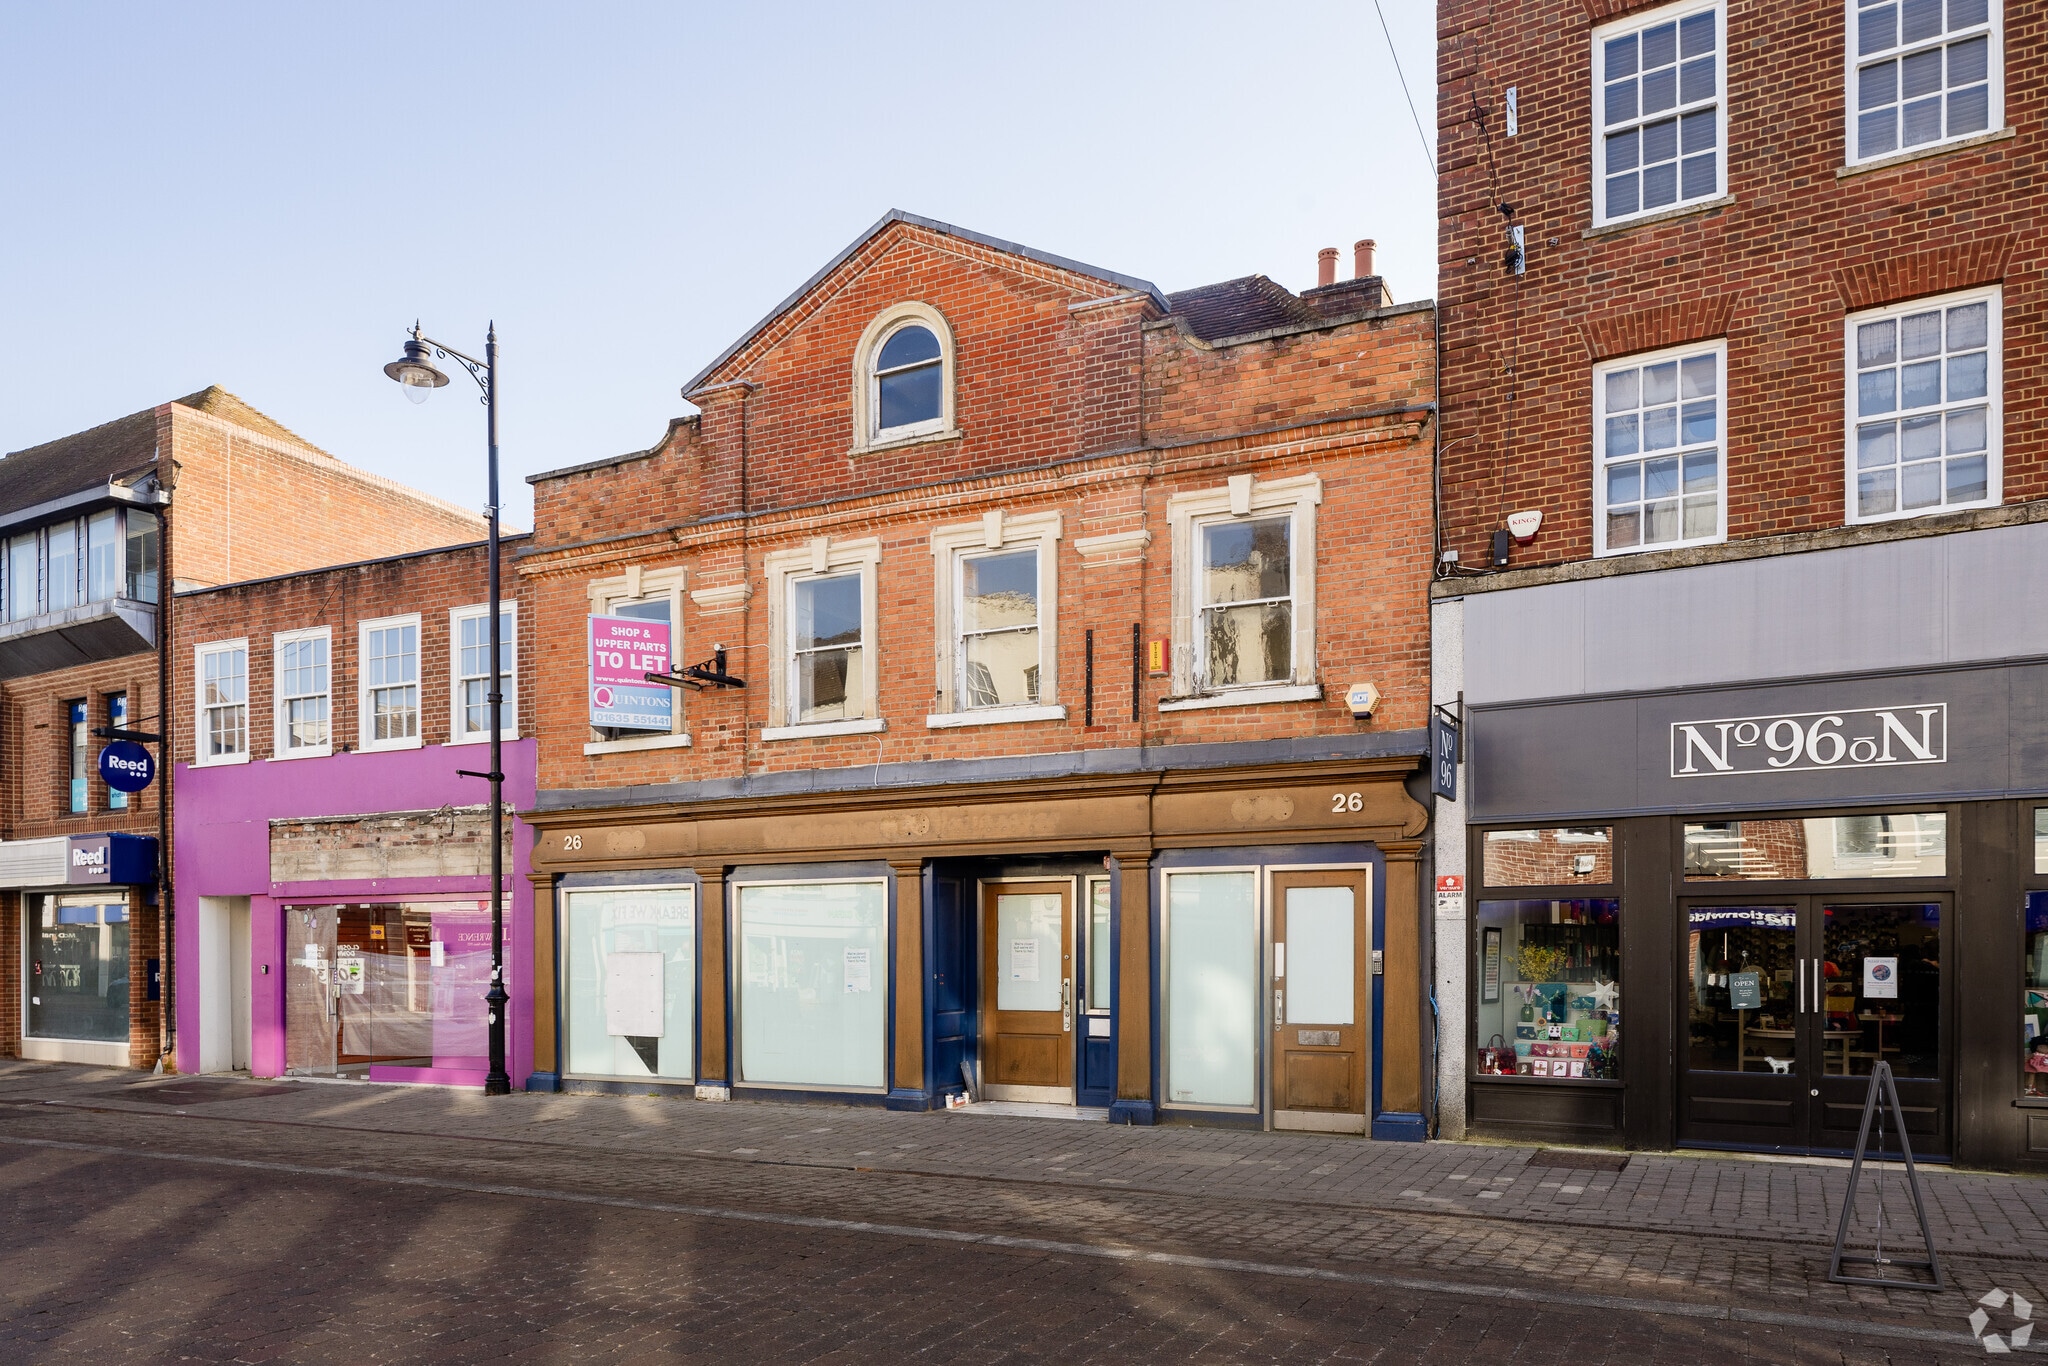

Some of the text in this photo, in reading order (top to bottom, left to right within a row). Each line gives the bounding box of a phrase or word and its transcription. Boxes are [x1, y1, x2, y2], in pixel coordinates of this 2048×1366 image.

[1512, 517, 1537, 525] KINGS
[611, 626, 651, 639] SHOP &
[595, 638, 667, 653] UPPER PARTS
[596, 651, 667, 672] TO LET
[594, 686, 671, 709] QUINTONS
[1352, 692, 1368, 702] ADT
[596, 713, 670, 725] 01635 551441
[108, 755, 148, 772] Reed
[1441, 761, 1452, 789] 96
[1331, 792, 1364, 813] 26
[564, 834, 582, 850] 26
[73, 846, 106, 867] Reed
